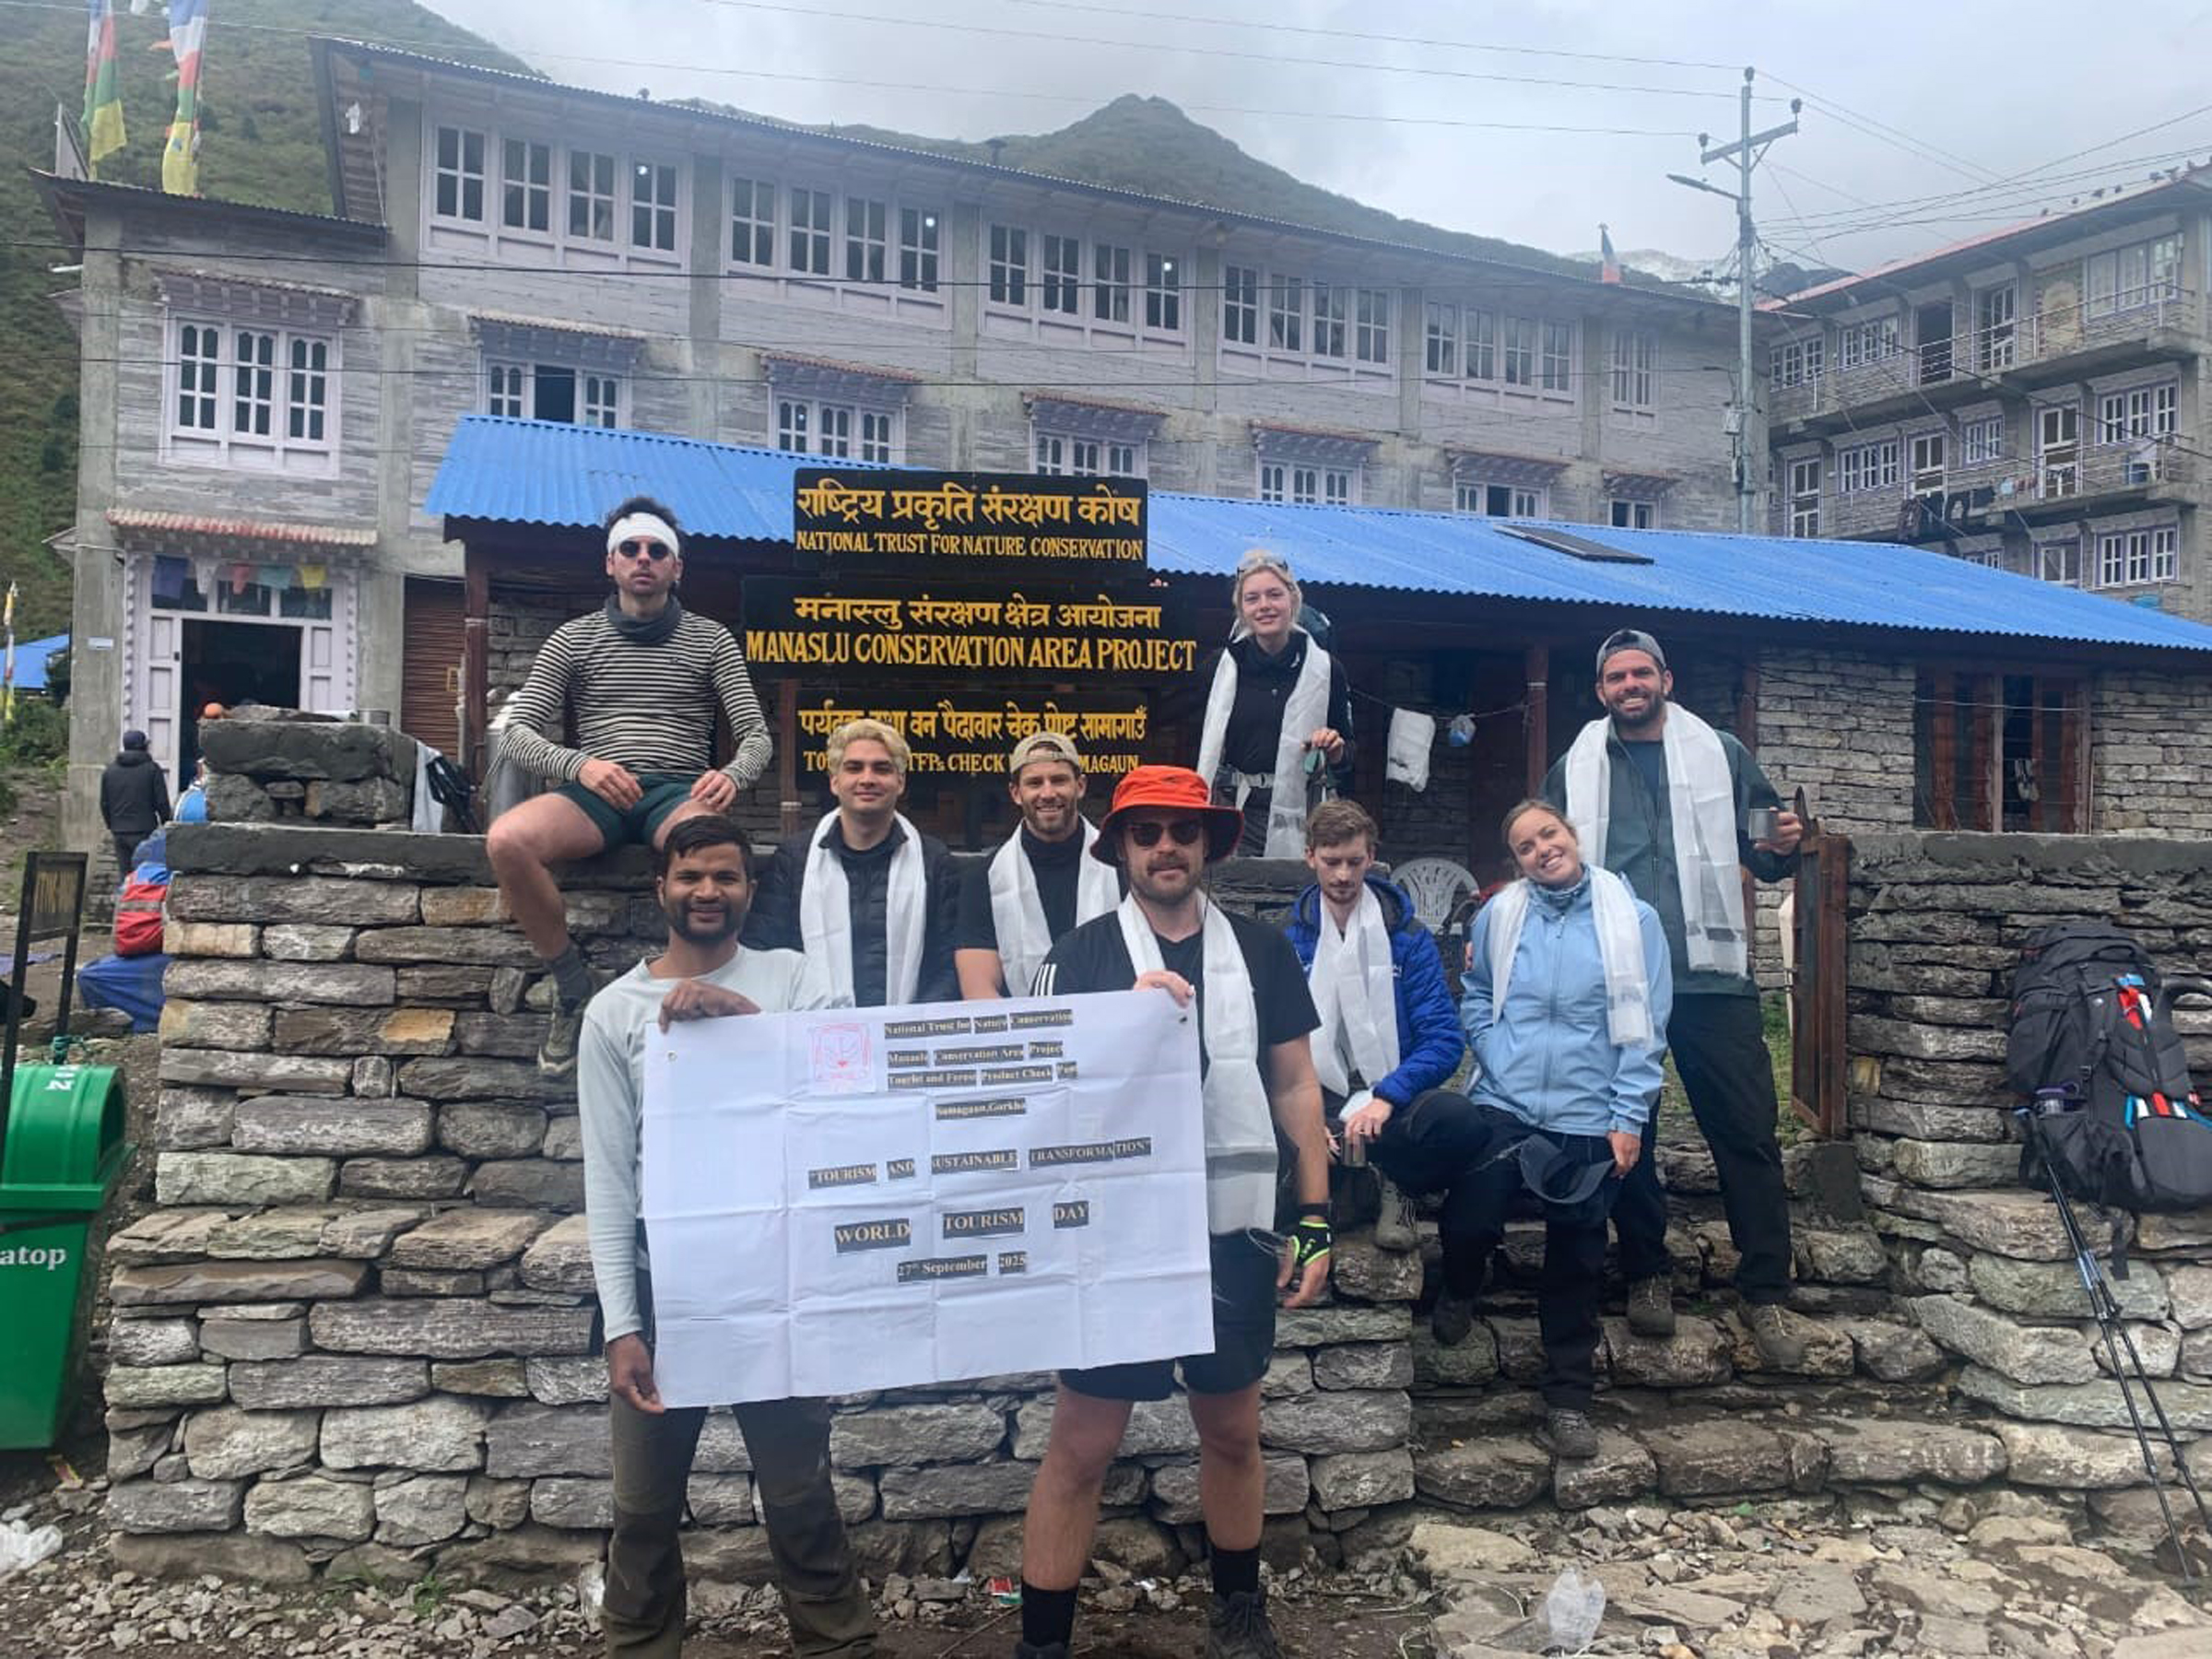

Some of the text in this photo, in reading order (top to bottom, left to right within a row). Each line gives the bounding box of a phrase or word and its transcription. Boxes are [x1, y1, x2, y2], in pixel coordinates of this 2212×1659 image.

[796, 477, 1141, 531] राष्ट्रिय प्रकृति संरक्षण कोष
[795, 531, 1144, 561] NATIONAL TRUST FOR NATURE CONSERVATION
[793, 593, 1162, 631] मनास्लु संरक्षण क्षेत्र आयोजना
[745, 629, 1197, 672] MANASLU CONSERVATION AREA PROJECT
[911, 711, 938, 738] वन
[947, 752, 1005, 772] CHECK
[1078, 755, 1140, 774] MAGAUN
[885, 1022, 926, 1035] National
[929, 1020, 954, 1031] Trust
[1030, 1042, 1064, 1056] Projec
[926, 1073, 944, 1084] and
[888, 1159, 914, 1175] AND
[836, 1204, 1087, 1245] WORLD TOURISM DAY
[923, 1258, 986, 1276] September
[999, 1255, 1026, 1270] 2025
